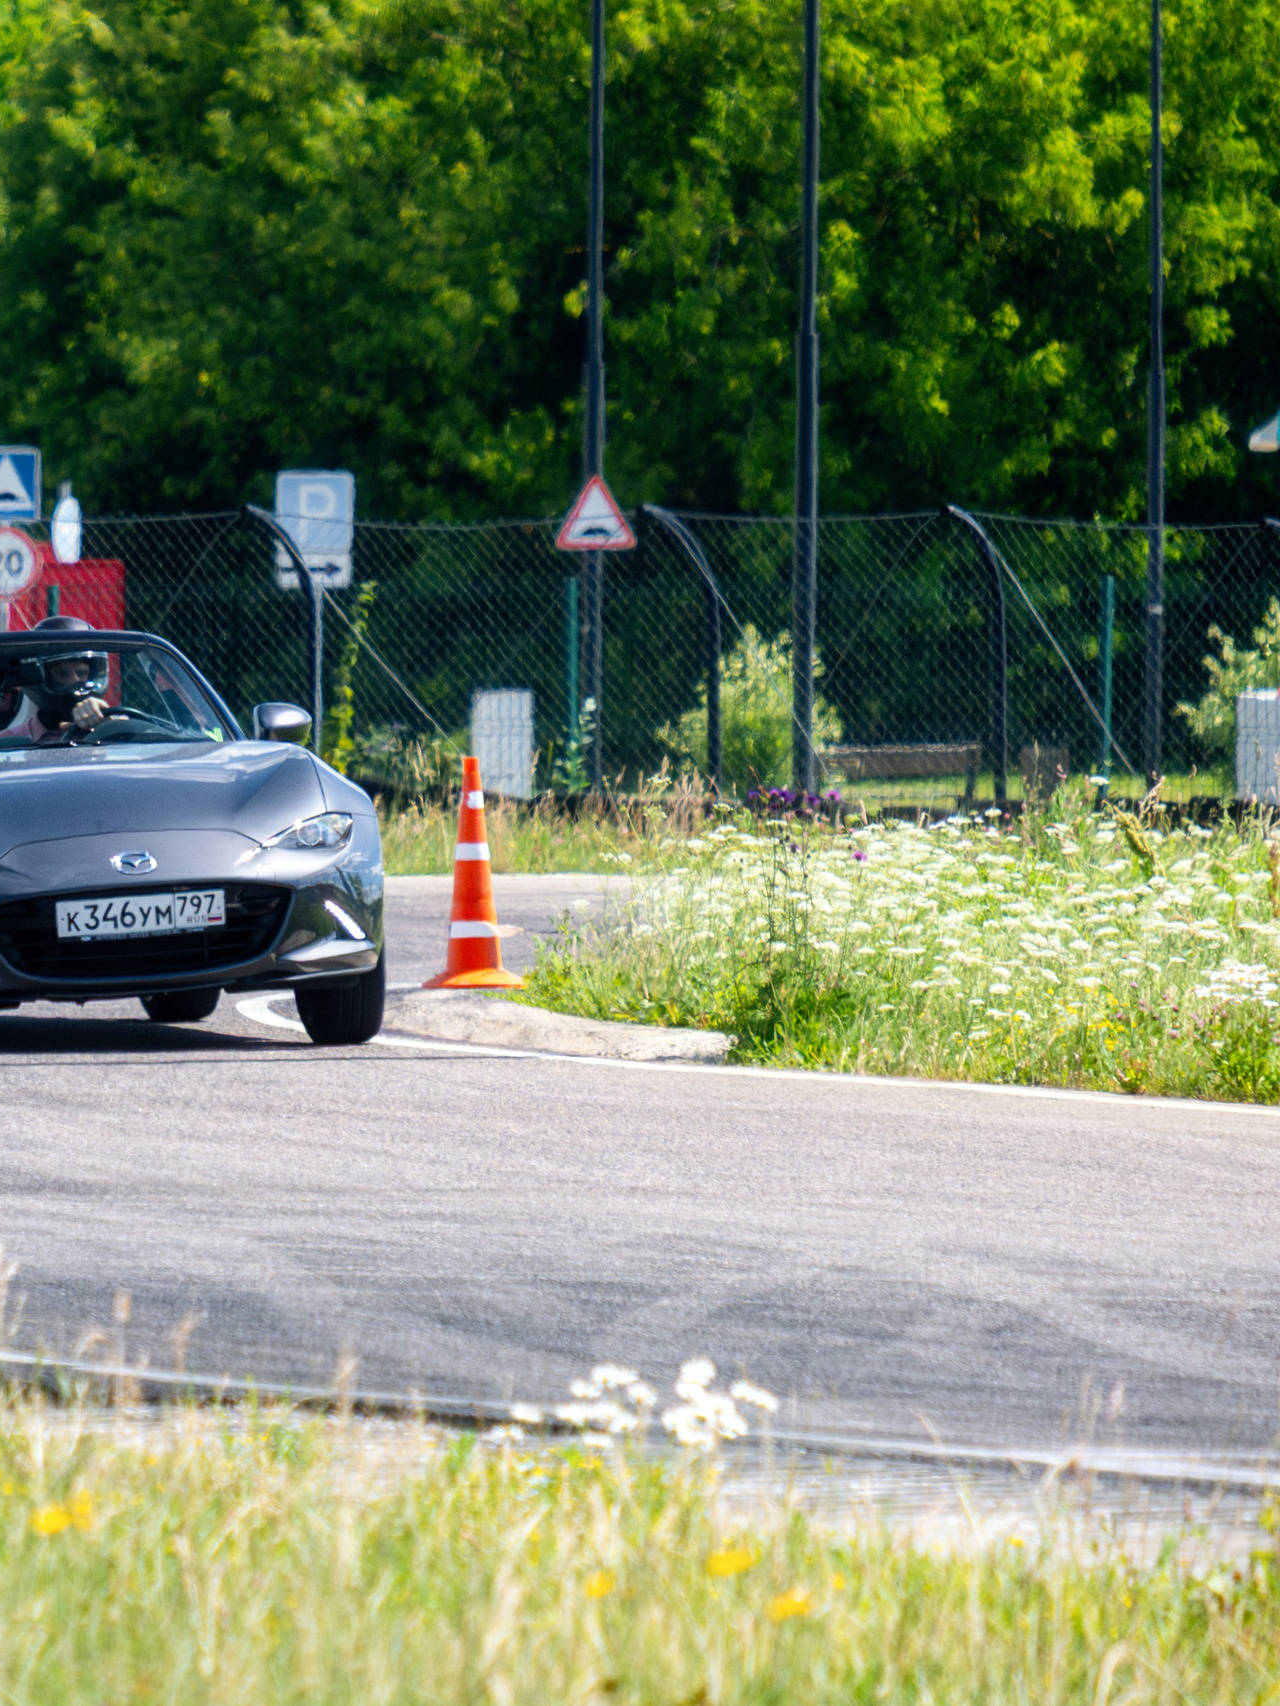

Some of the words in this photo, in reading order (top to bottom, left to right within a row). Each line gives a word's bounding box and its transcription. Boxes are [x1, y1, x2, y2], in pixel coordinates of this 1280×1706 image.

[299, 484, 336, 543] P
[176, 894, 215, 916] 797
[187, 915, 207, 923] RUS
